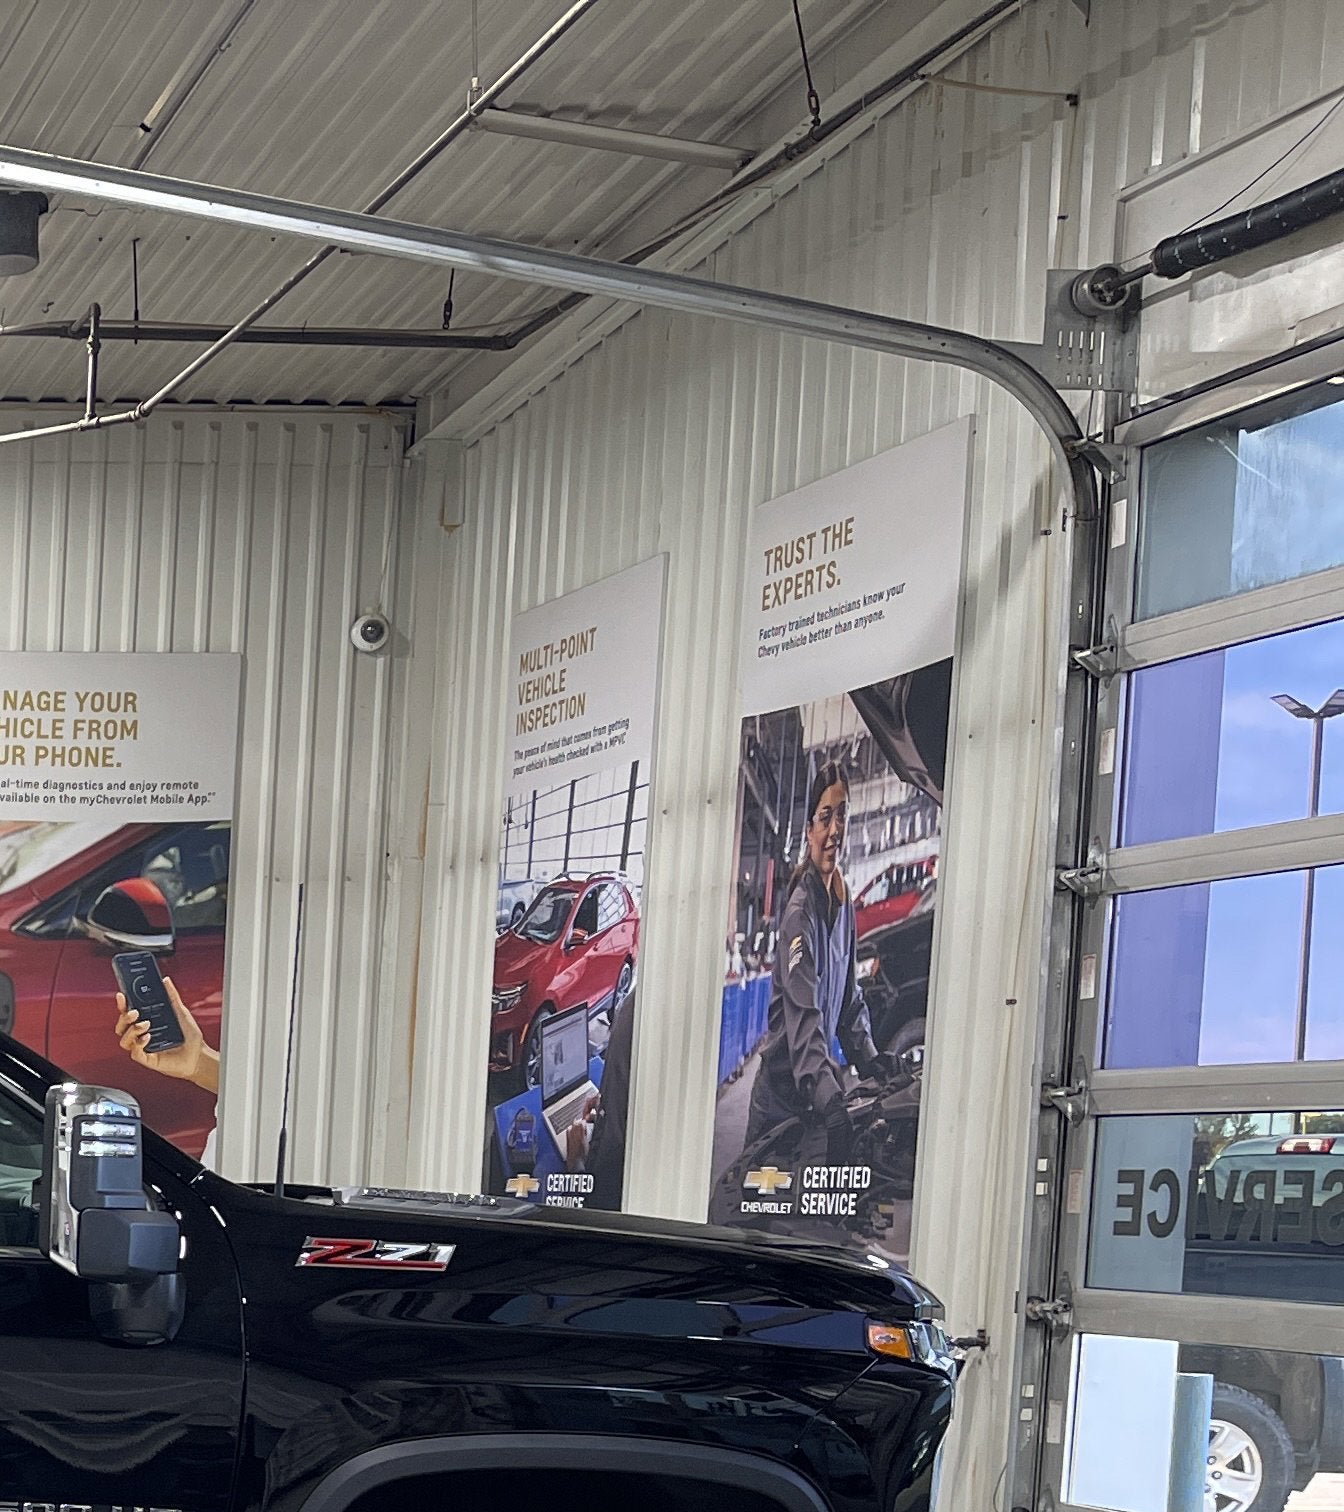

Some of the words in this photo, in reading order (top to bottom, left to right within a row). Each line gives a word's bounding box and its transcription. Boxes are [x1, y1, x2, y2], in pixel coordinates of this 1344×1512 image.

[764, 531, 816, 576] TRUST
[821, 516, 855, 554] THE
[762, 560, 841, 612] EXPERTS.
[759, 623, 787, 640] Factory
[788, 612, 815, 631] trained
[816, 599, 861, 622] technicians
[863, 591, 884, 607] know
[886, 582, 906, 602] your
[758, 643, 780, 658] Chevy
[781, 633, 807, 651] vehicle
[809, 626, 833, 643] better
[834, 619, 852, 635] than
[854, 609, 885, 629] anyone.
[519, 626, 597, 677] MULTI-POINT
[518, 668, 567, 706] VEHICLE
[75, 691, 138, 713] YOUR
[516, 692, 586, 736] INSPECTION
[73, 719, 139, 740] FROM
[561, 735, 573, 747] that
[573, 731, 592, 743] comes
[592, 725, 606, 737] from
[607, 718, 630, 736] getting
[34, 746, 122, 768] PHONE.
[43, 779, 103, 792] diagnostics
[106, 780, 126, 790] and
[129, 780, 158, 793] enjoy
[161, 781, 199, 790] remote
[43, 795, 55, 804] on
[59, 794, 76, 804] the
[80, 794, 147, 806] myChevrolet
[150, 794, 184, 805] Mobile
[547, 1173, 594, 1193] CERTIFIED
[803, 1166, 871, 1189] CERTIFIED
[741, 1201, 792, 1214] CHEVROLET
[801, 1193, 857, 1215] SERVICE
[296, 1236, 457, 1271] Z71
